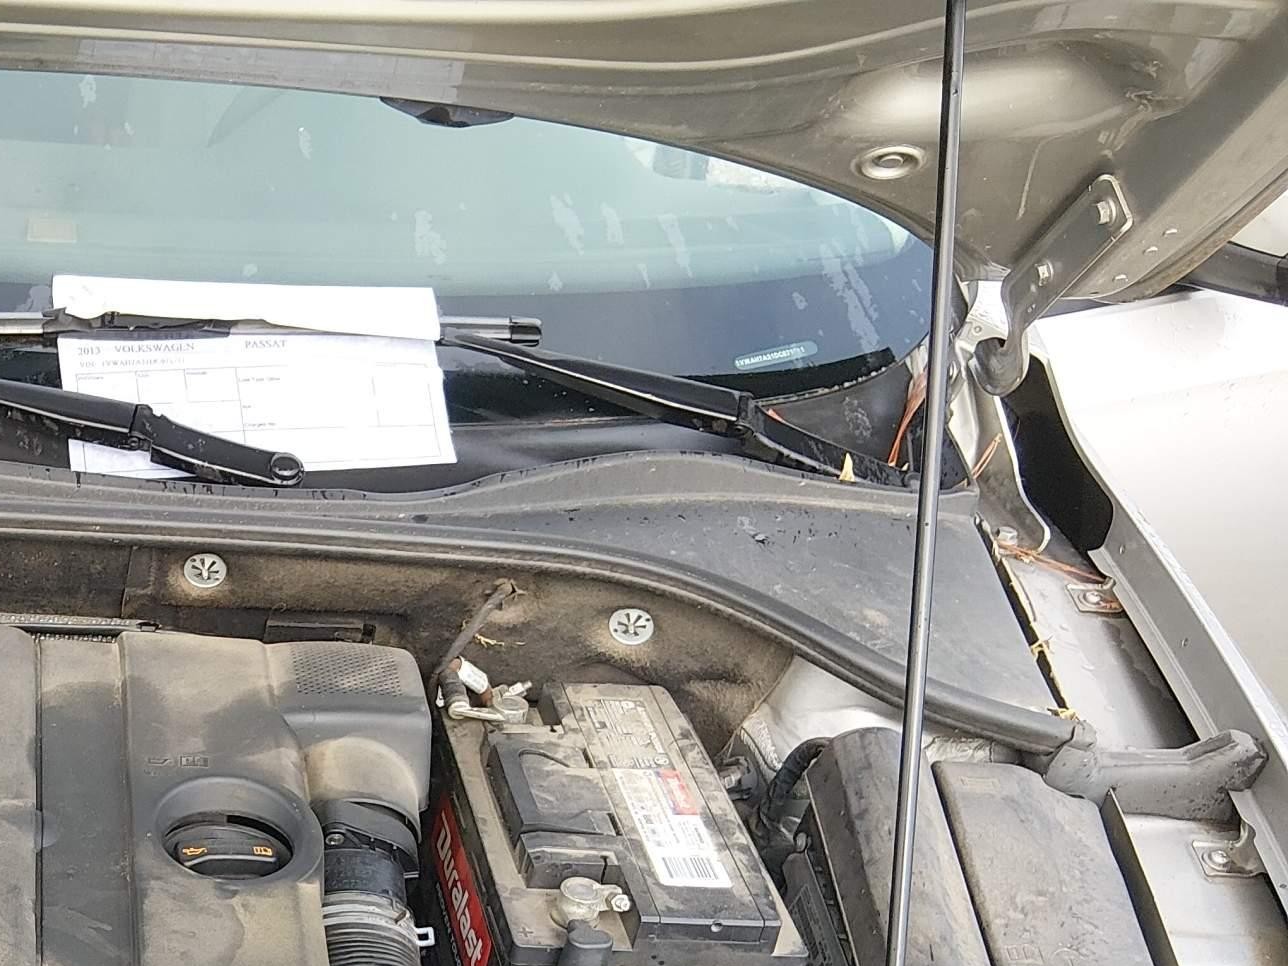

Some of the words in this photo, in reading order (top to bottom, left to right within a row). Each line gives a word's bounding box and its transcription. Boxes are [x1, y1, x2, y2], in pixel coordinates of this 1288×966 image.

[78, 347, 101, 356] 2013
[115, 343, 195, 353] VOLKSWAGEN
[245, 340, 287, 349] PASSAT
